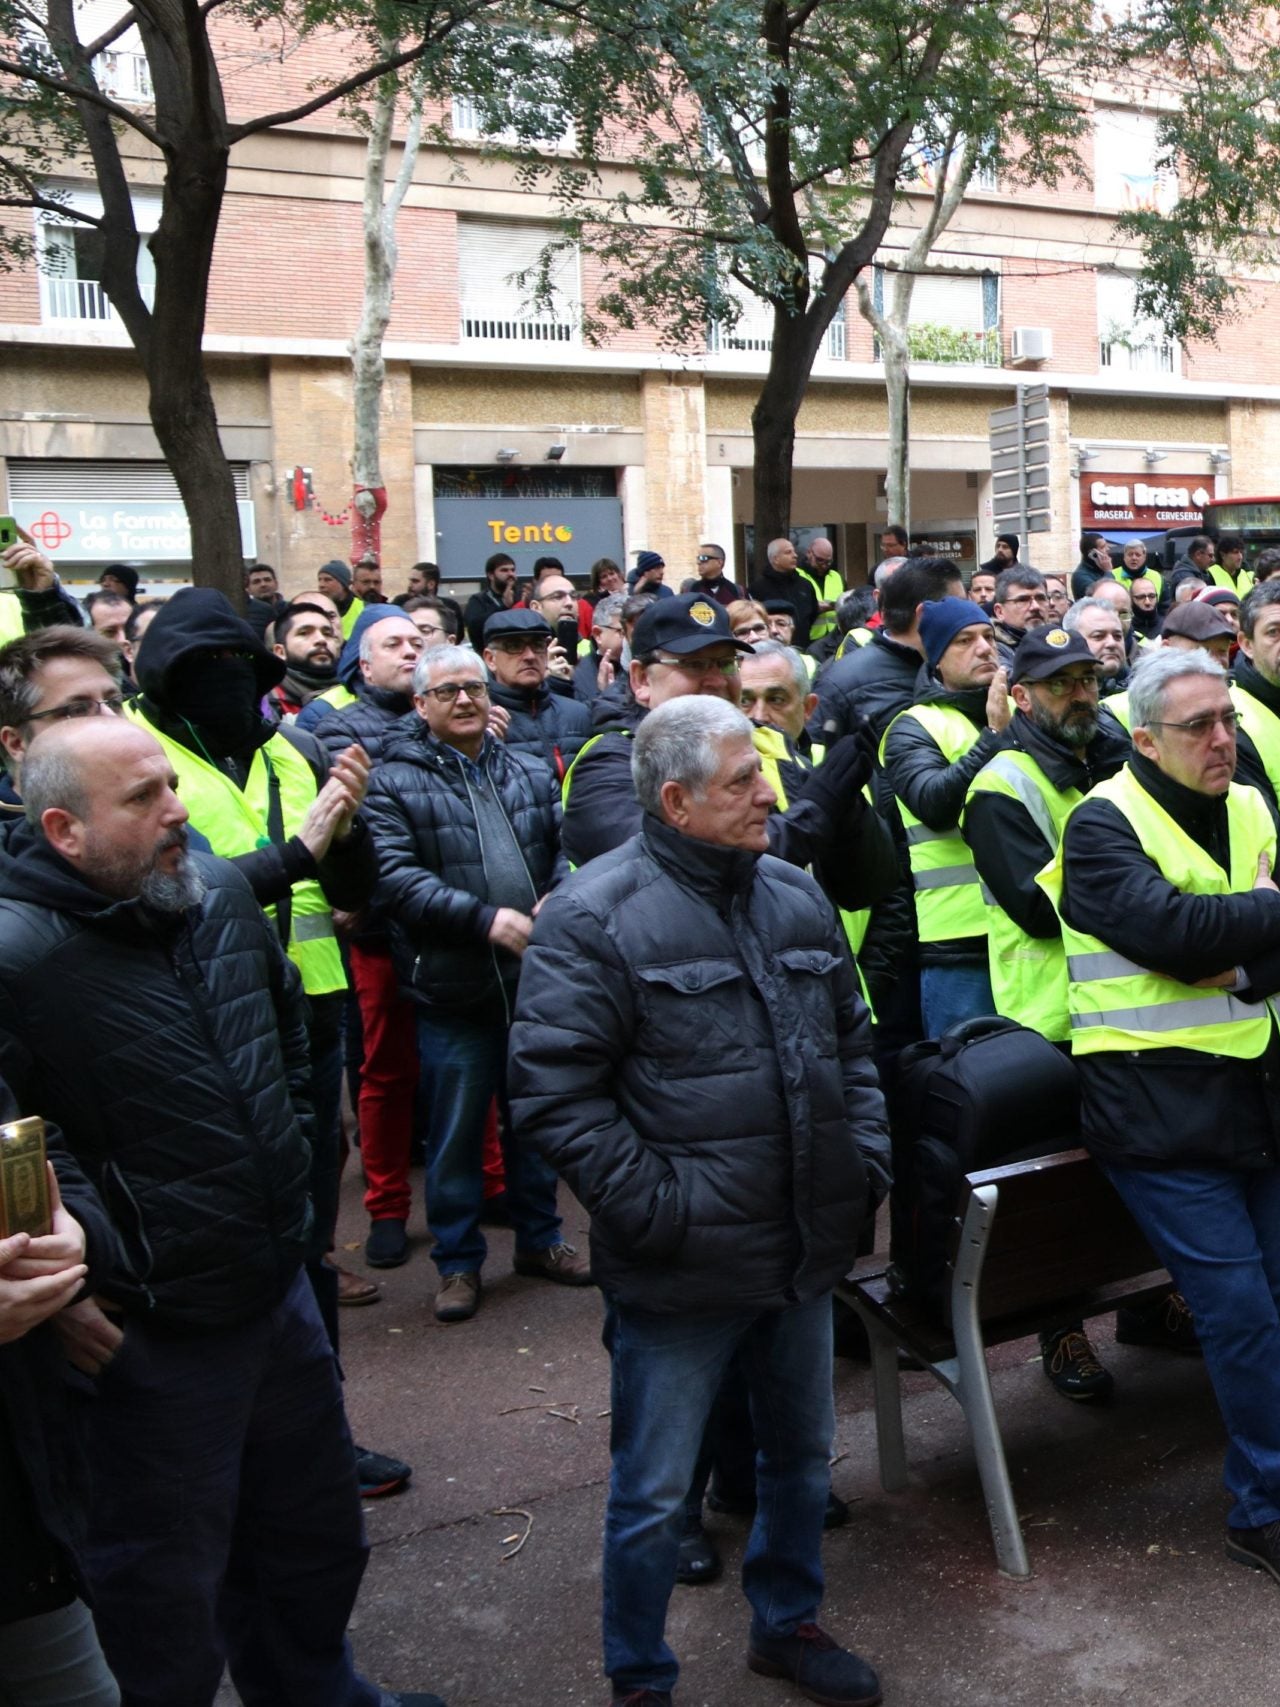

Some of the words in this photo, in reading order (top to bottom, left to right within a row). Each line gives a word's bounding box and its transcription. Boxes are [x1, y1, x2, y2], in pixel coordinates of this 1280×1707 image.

[1091, 481, 1130, 506] Can
[1134, 482, 1189, 507] Brasa
[79, 510, 107, 530] La
[1094, 510, 1134, 520] BRASERIA
[1156, 510, 1203, 521] CERVESERIA
[81, 531, 112, 550] de
[116, 530, 190, 550] Tarrad
[488, 520, 573, 544] Tento
